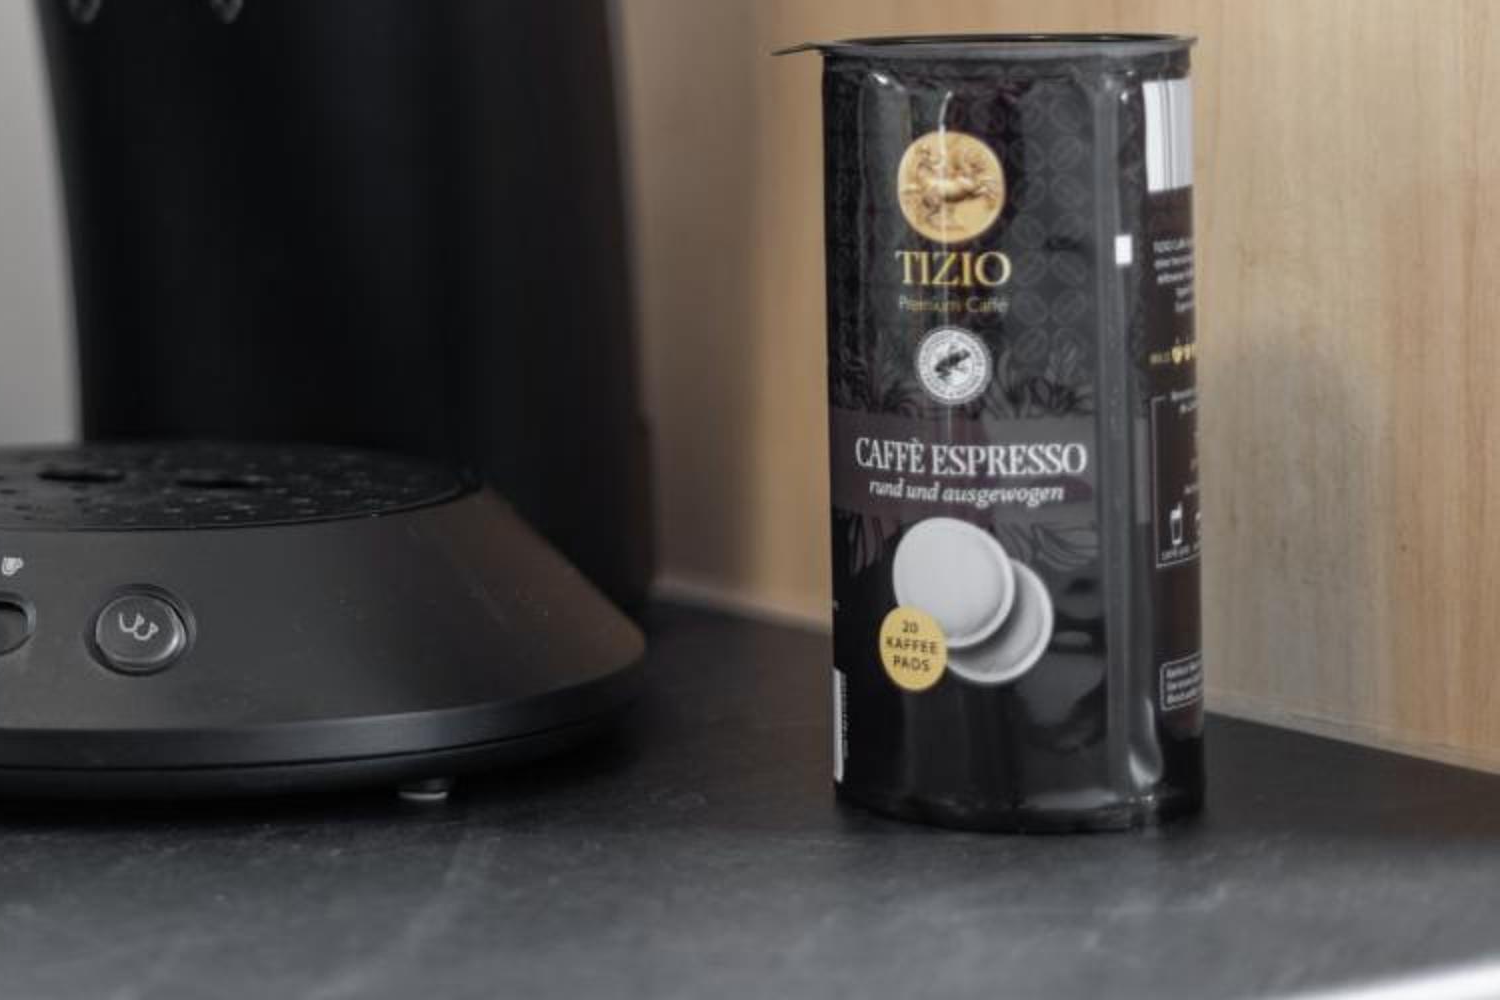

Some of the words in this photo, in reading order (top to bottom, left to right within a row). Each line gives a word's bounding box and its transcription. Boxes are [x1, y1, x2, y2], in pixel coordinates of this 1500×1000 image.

[894, 250, 1012, 287] TIZIO
[855, 436, 925, 474] CAFFÈ
[930, 443, 1088, 476] ESPRESSO
[869, 478, 903, 499] rund
[906, 481, 940, 502] und
[941, 485, 1065, 509] ausgewogen
[901, 619, 919, 634] 20
[885, 636, 938, 656] KAFFEE
[893, 654, 931, 673] PADS
